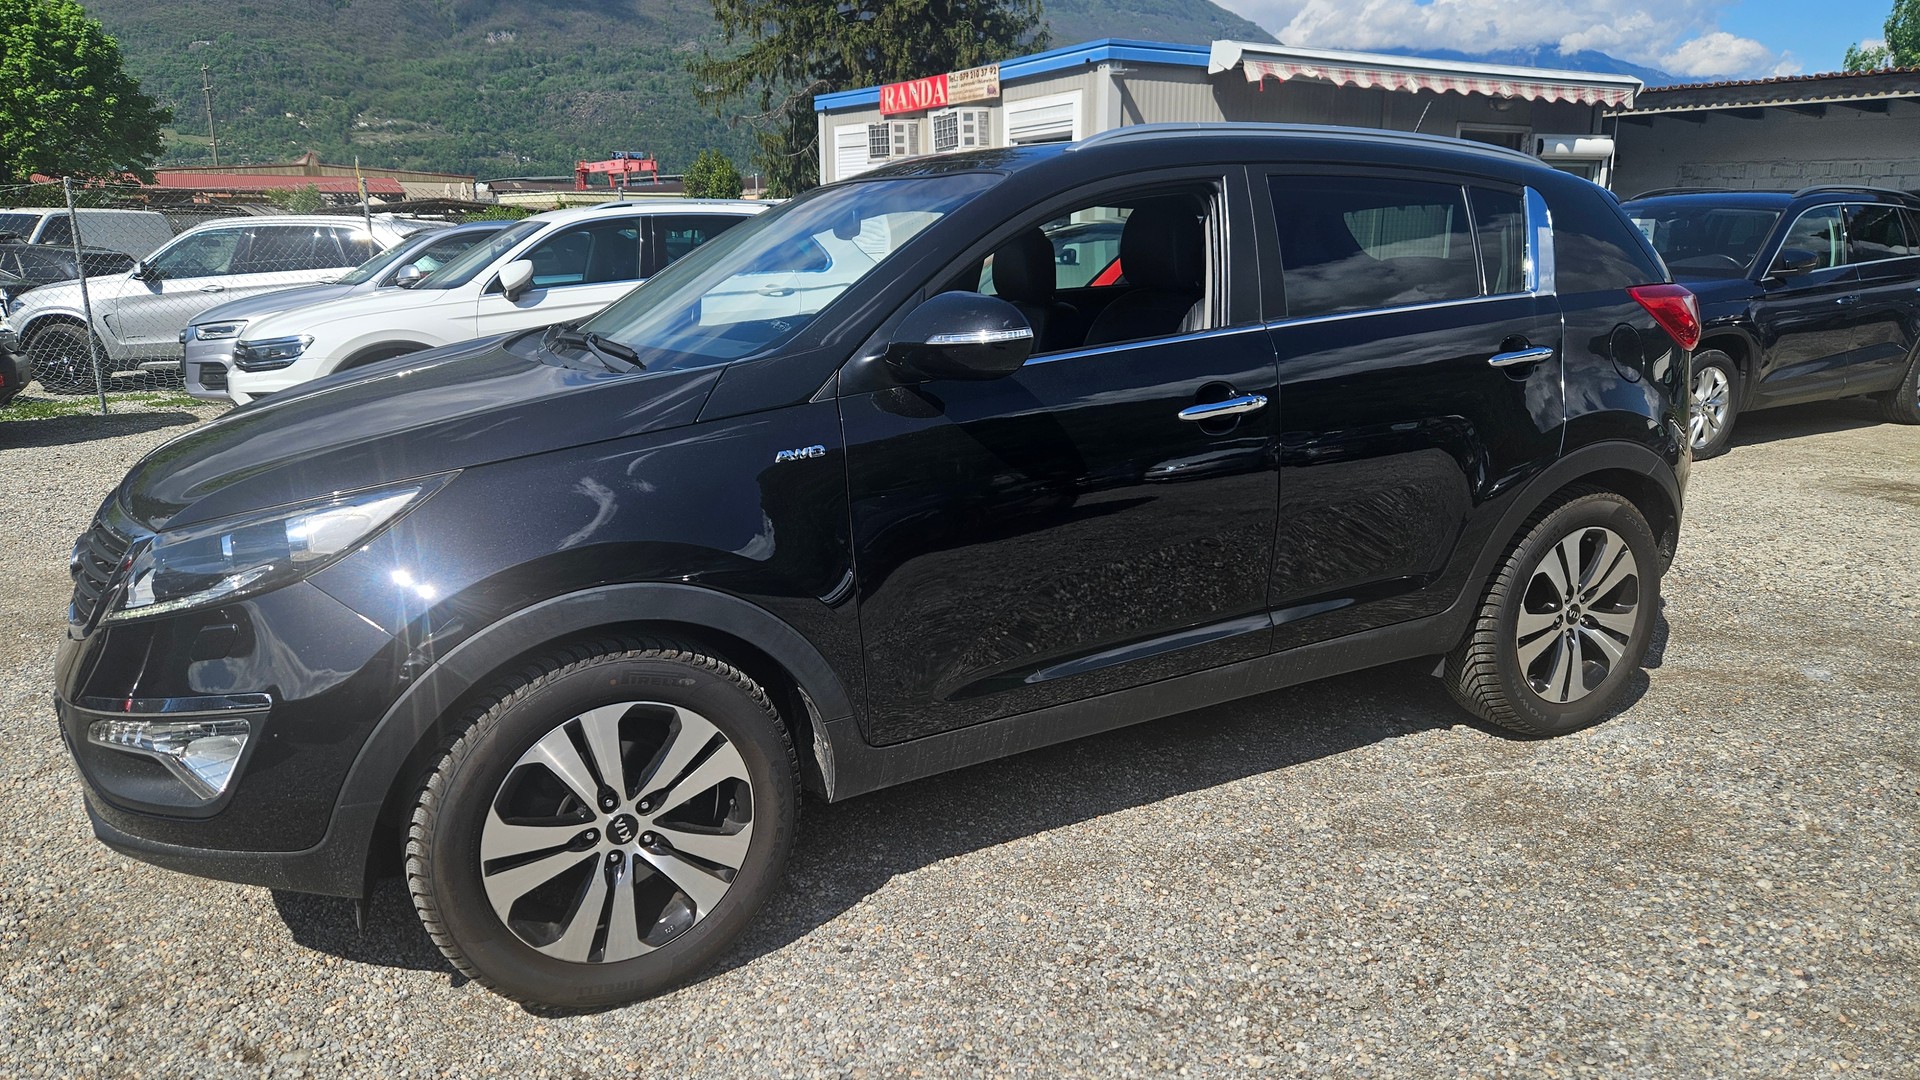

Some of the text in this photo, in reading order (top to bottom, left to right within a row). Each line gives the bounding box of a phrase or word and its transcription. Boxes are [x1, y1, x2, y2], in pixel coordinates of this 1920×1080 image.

[884, 77, 947, 112] RANDA
[775, 445, 825, 463] AWD
[1569, 609, 1580, 619] KIA
[614, 817, 632, 842] KIA
